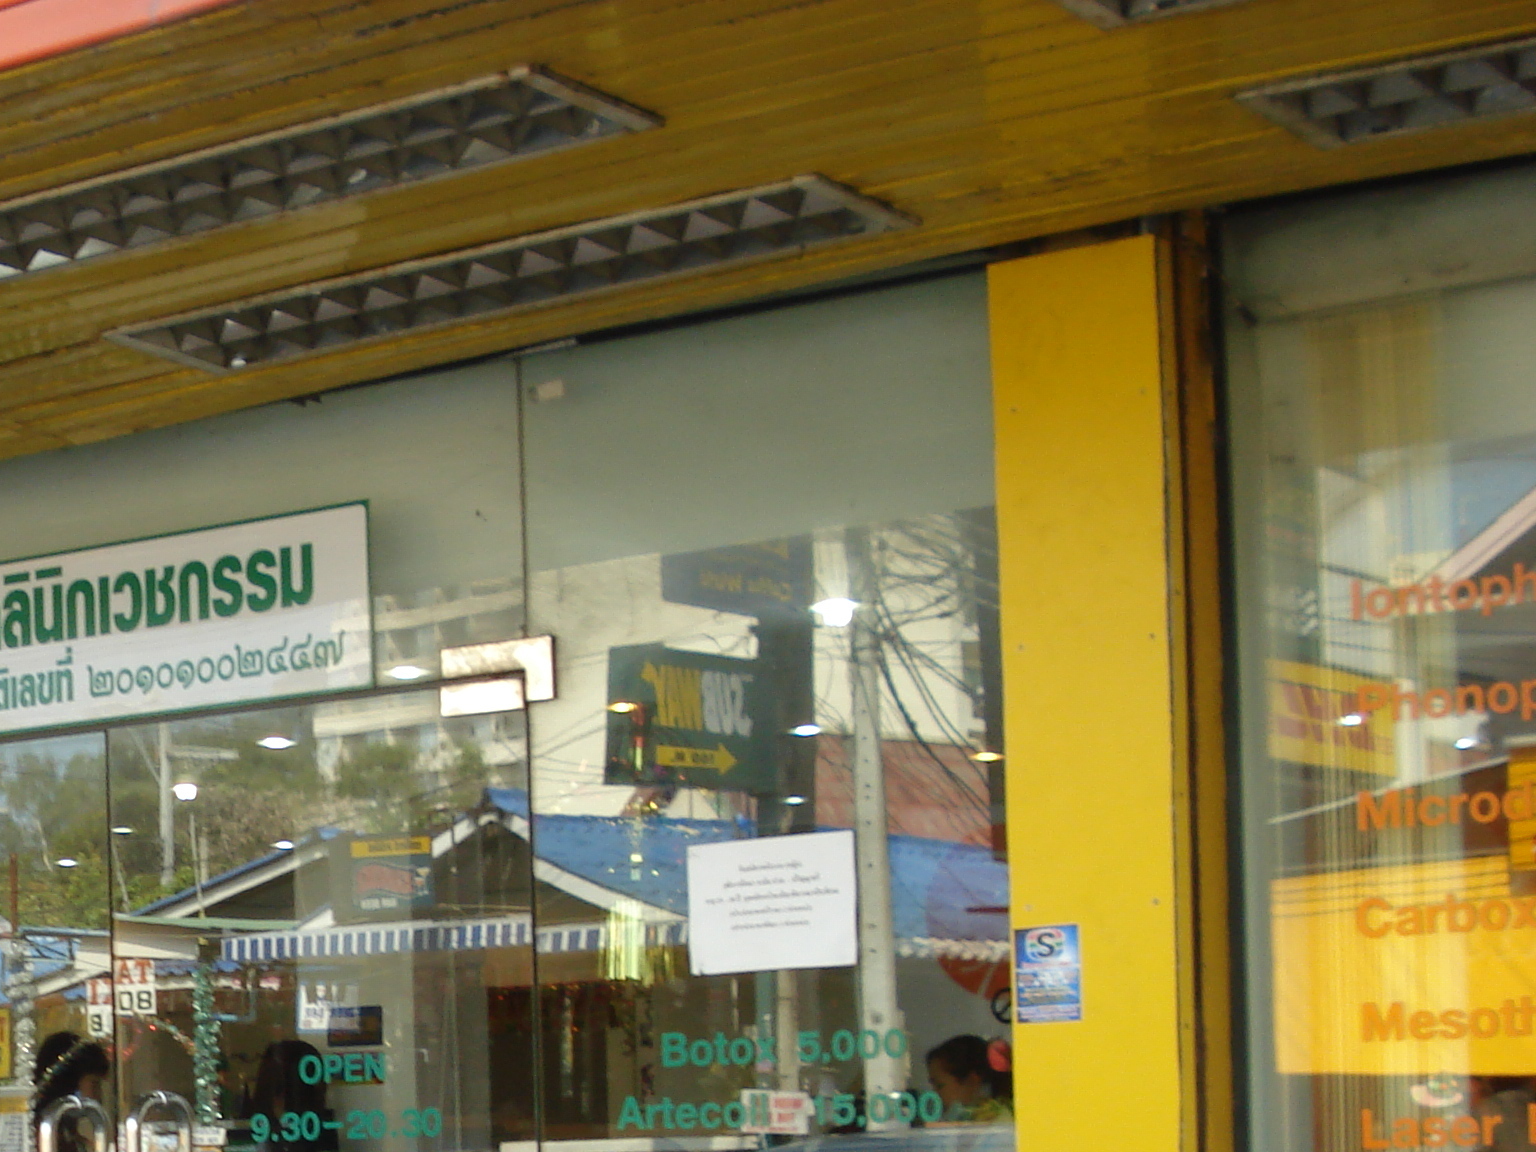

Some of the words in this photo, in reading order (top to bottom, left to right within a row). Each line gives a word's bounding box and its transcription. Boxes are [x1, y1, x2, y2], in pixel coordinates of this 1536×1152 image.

[661, 1031, 776, 1068] Botox
[298, 1053, 386, 1085] OPEN
[1361, 1107, 1503, 1151] Laser
